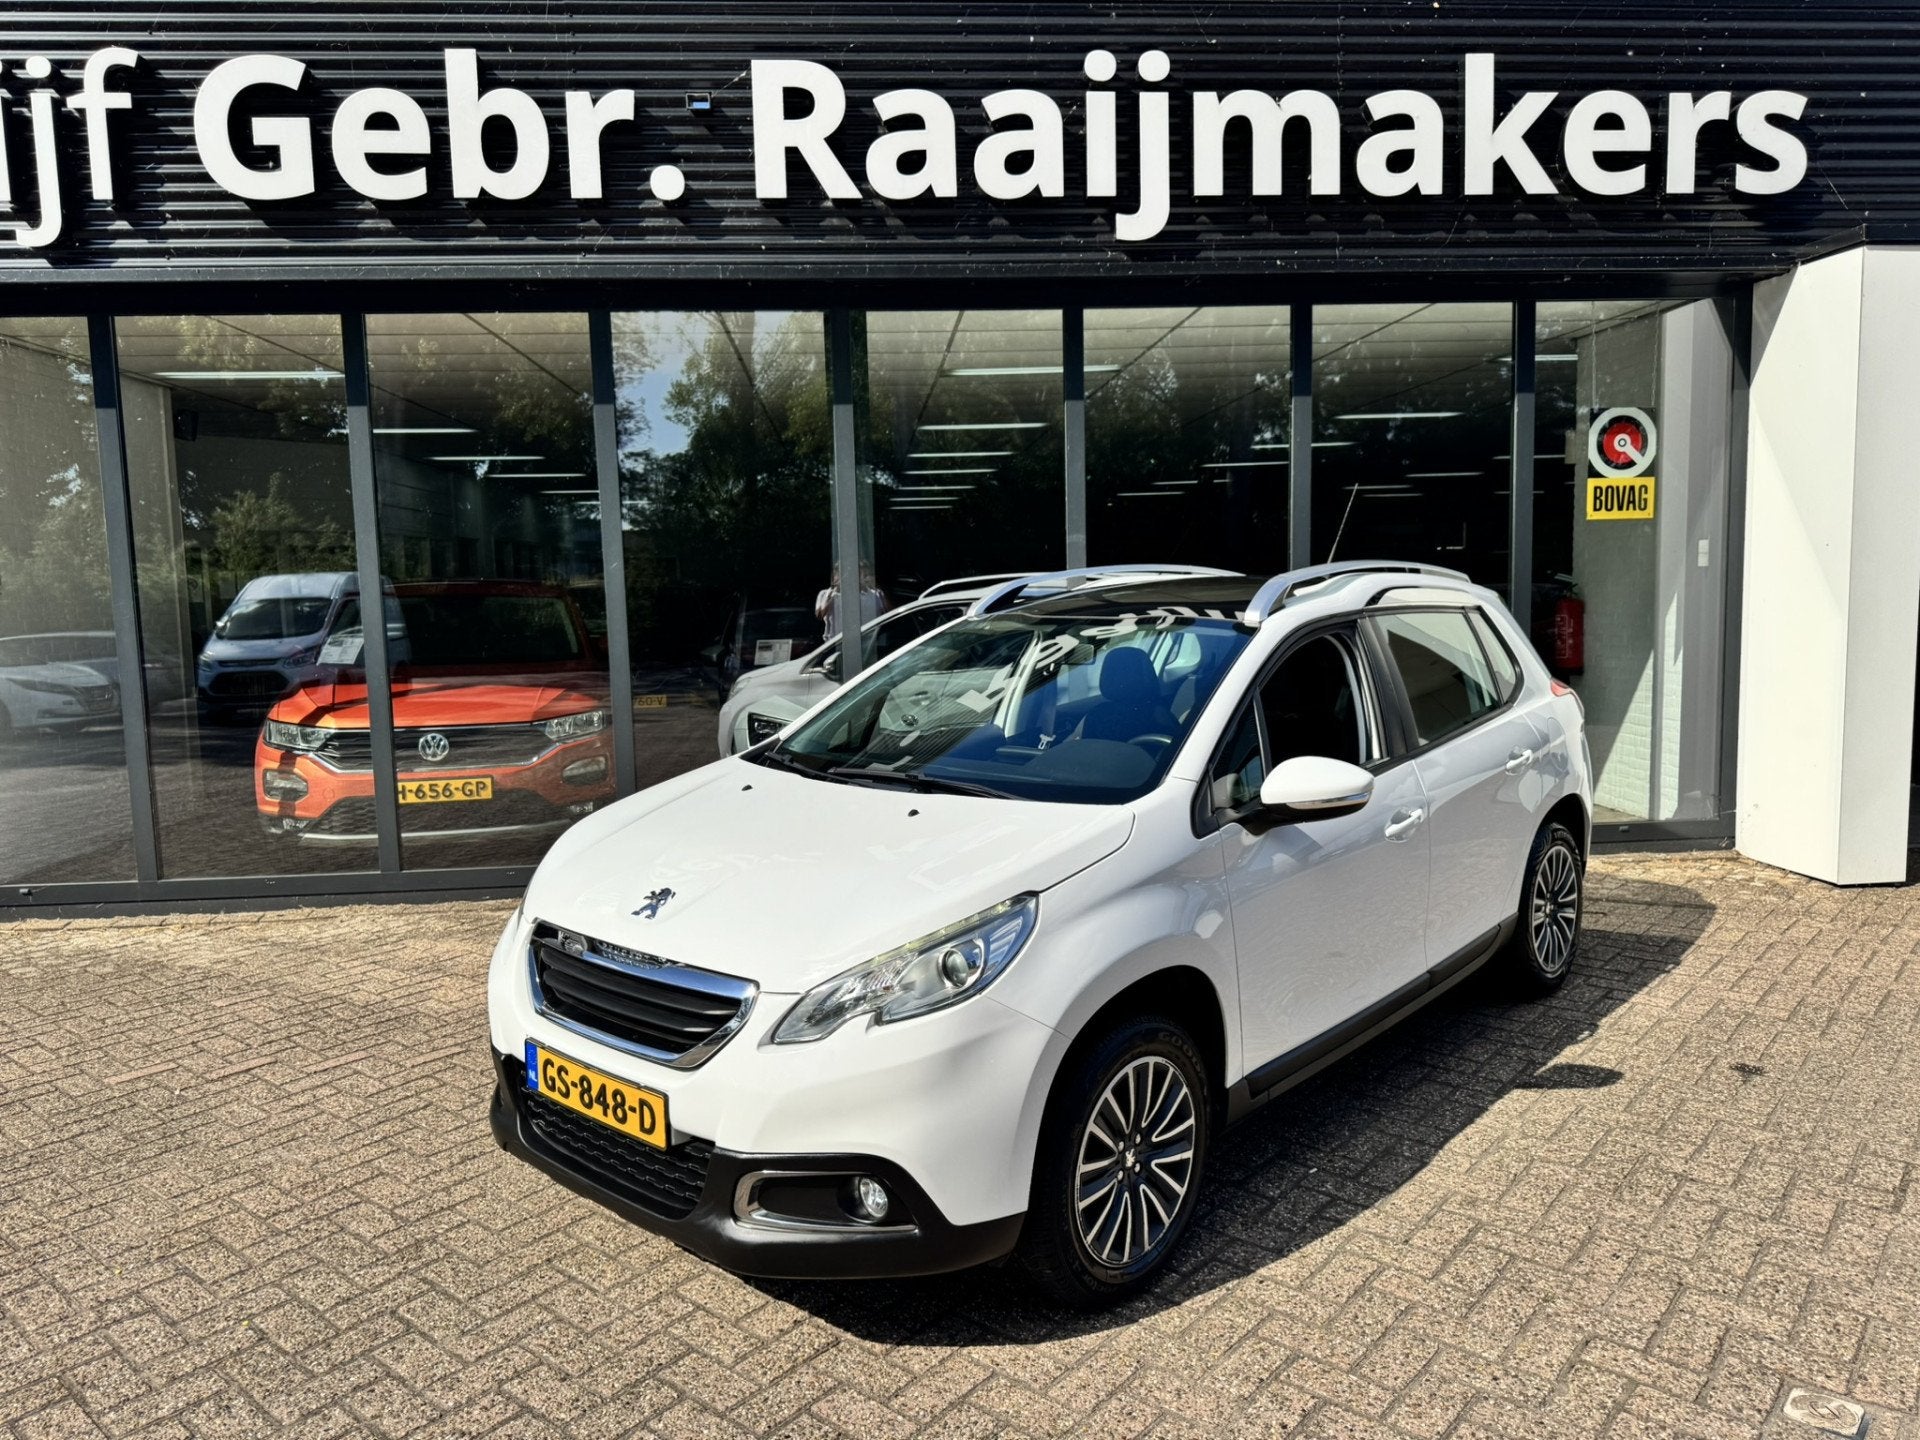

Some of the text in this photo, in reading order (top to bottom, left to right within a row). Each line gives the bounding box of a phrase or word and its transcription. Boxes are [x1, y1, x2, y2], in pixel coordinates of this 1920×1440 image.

[0, 47, 1808, 248] jf Gebr. Raaijmakers
[1592, 484, 1649, 512] BOVAG
[528, 1057, 657, 1136] NL GS-848-D
